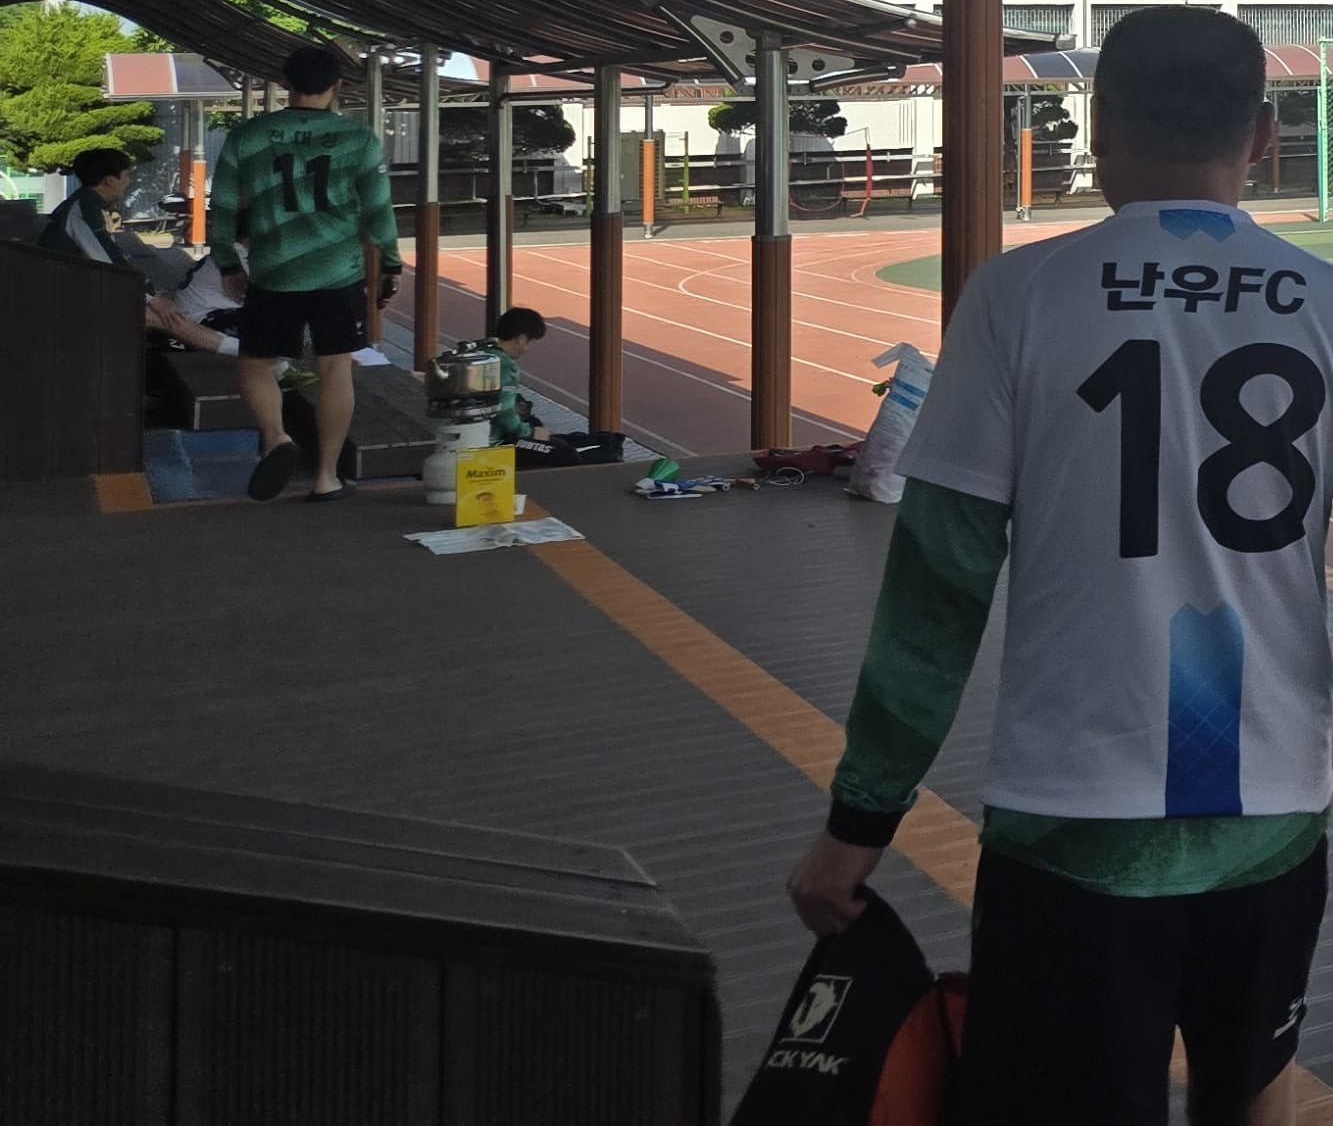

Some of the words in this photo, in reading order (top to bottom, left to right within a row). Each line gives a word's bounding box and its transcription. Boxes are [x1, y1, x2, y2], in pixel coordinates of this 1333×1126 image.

[273, 154, 331, 212] 11
[1101, 261, 1308, 315] 난우FC
[465, 469, 506, 479] Maxim
[1075, 338, 1327, 559] 18
